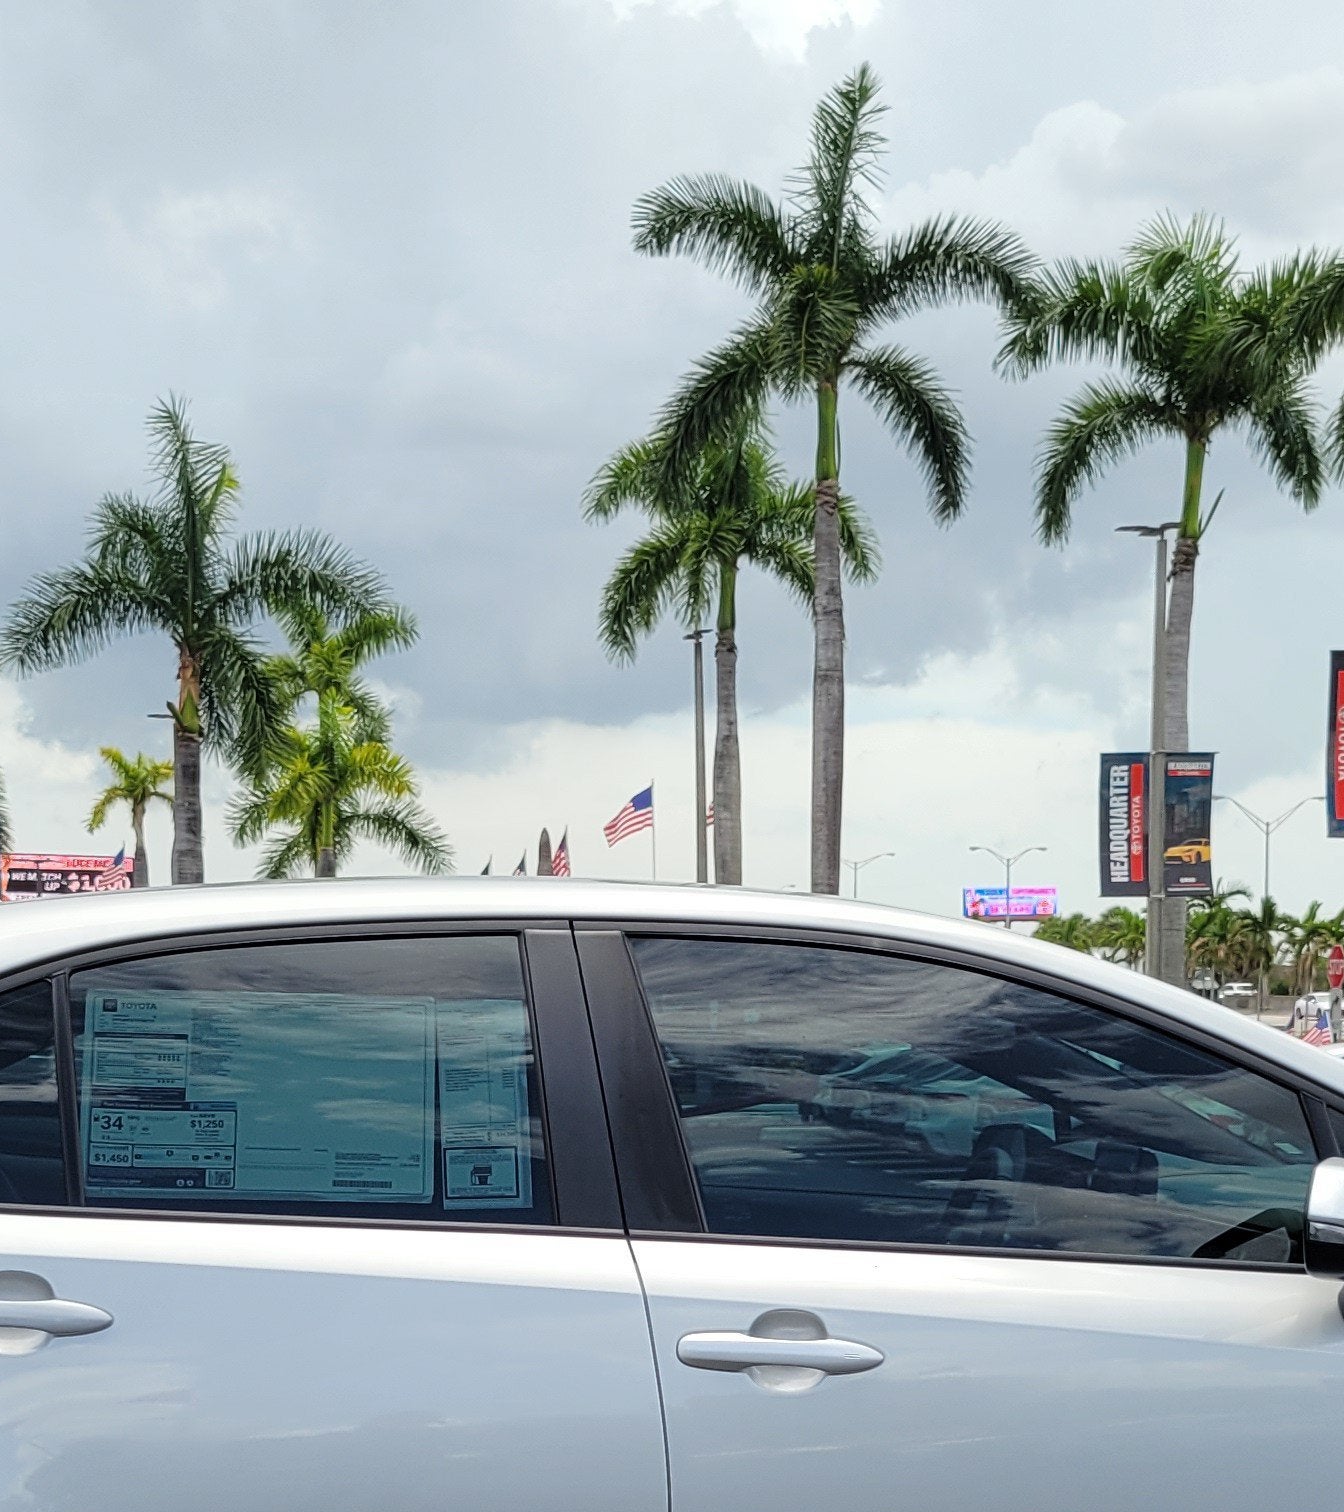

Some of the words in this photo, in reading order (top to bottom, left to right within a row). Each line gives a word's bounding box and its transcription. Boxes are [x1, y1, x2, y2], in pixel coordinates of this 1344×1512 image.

[1109, 764, 1130, 883] HEADQUARTER
[1131, 795, 1142, 842] TOYOTA
[121, 1002, 157, 1010] TOYOTA
[100, 1115, 124, 1131] 34
[190, 1119, 224, 1129] $1,250
[94, 1153, 129, 1164] $1,450
